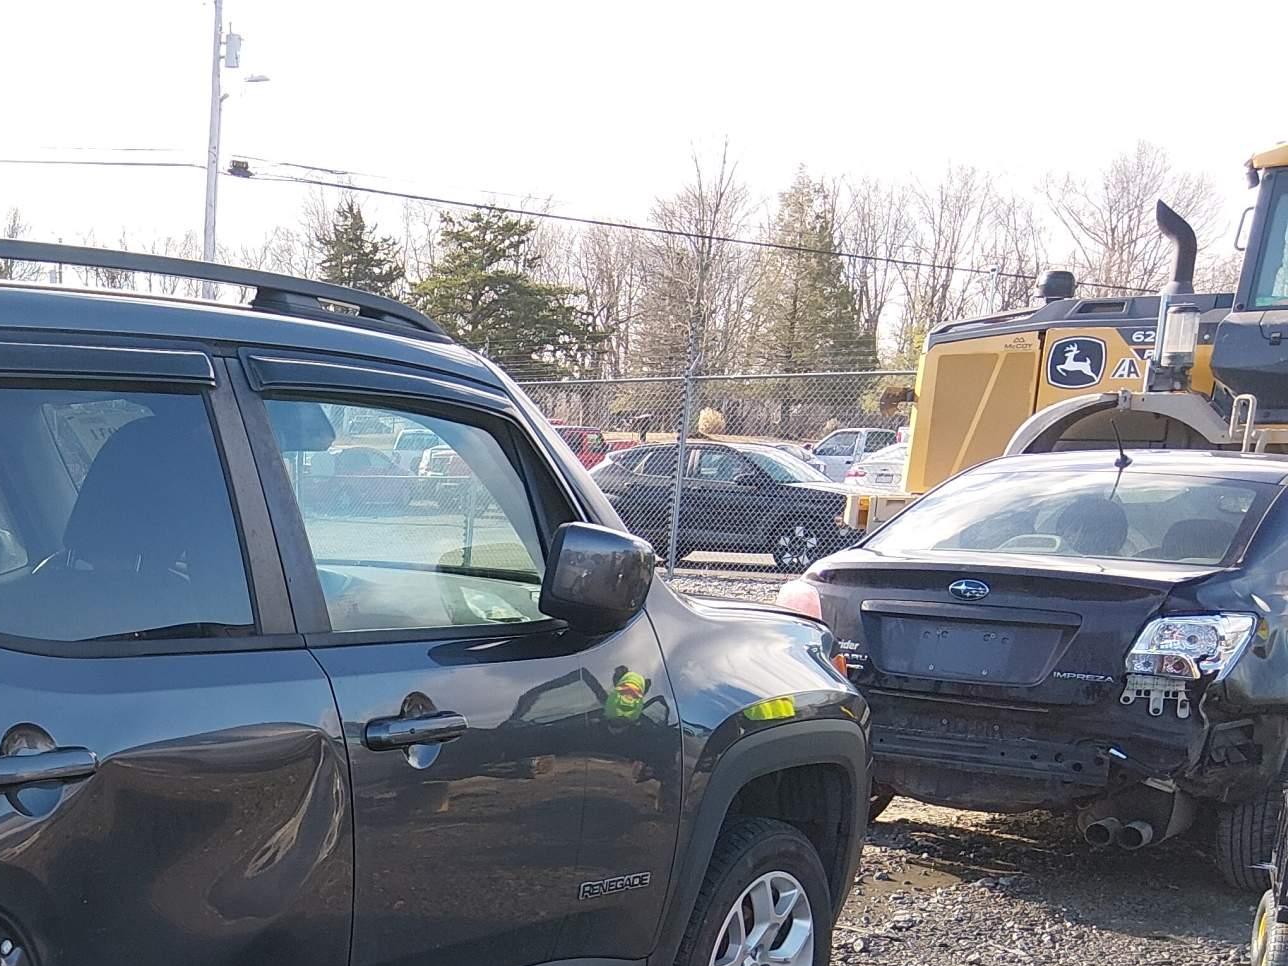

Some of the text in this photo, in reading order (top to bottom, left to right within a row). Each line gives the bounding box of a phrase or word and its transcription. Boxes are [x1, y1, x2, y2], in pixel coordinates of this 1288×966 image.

[1131, 330, 1155, 343] 62
[1052, 671, 1115, 684] IMPREZA
[578, 871, 651, 900] RENEGADE
